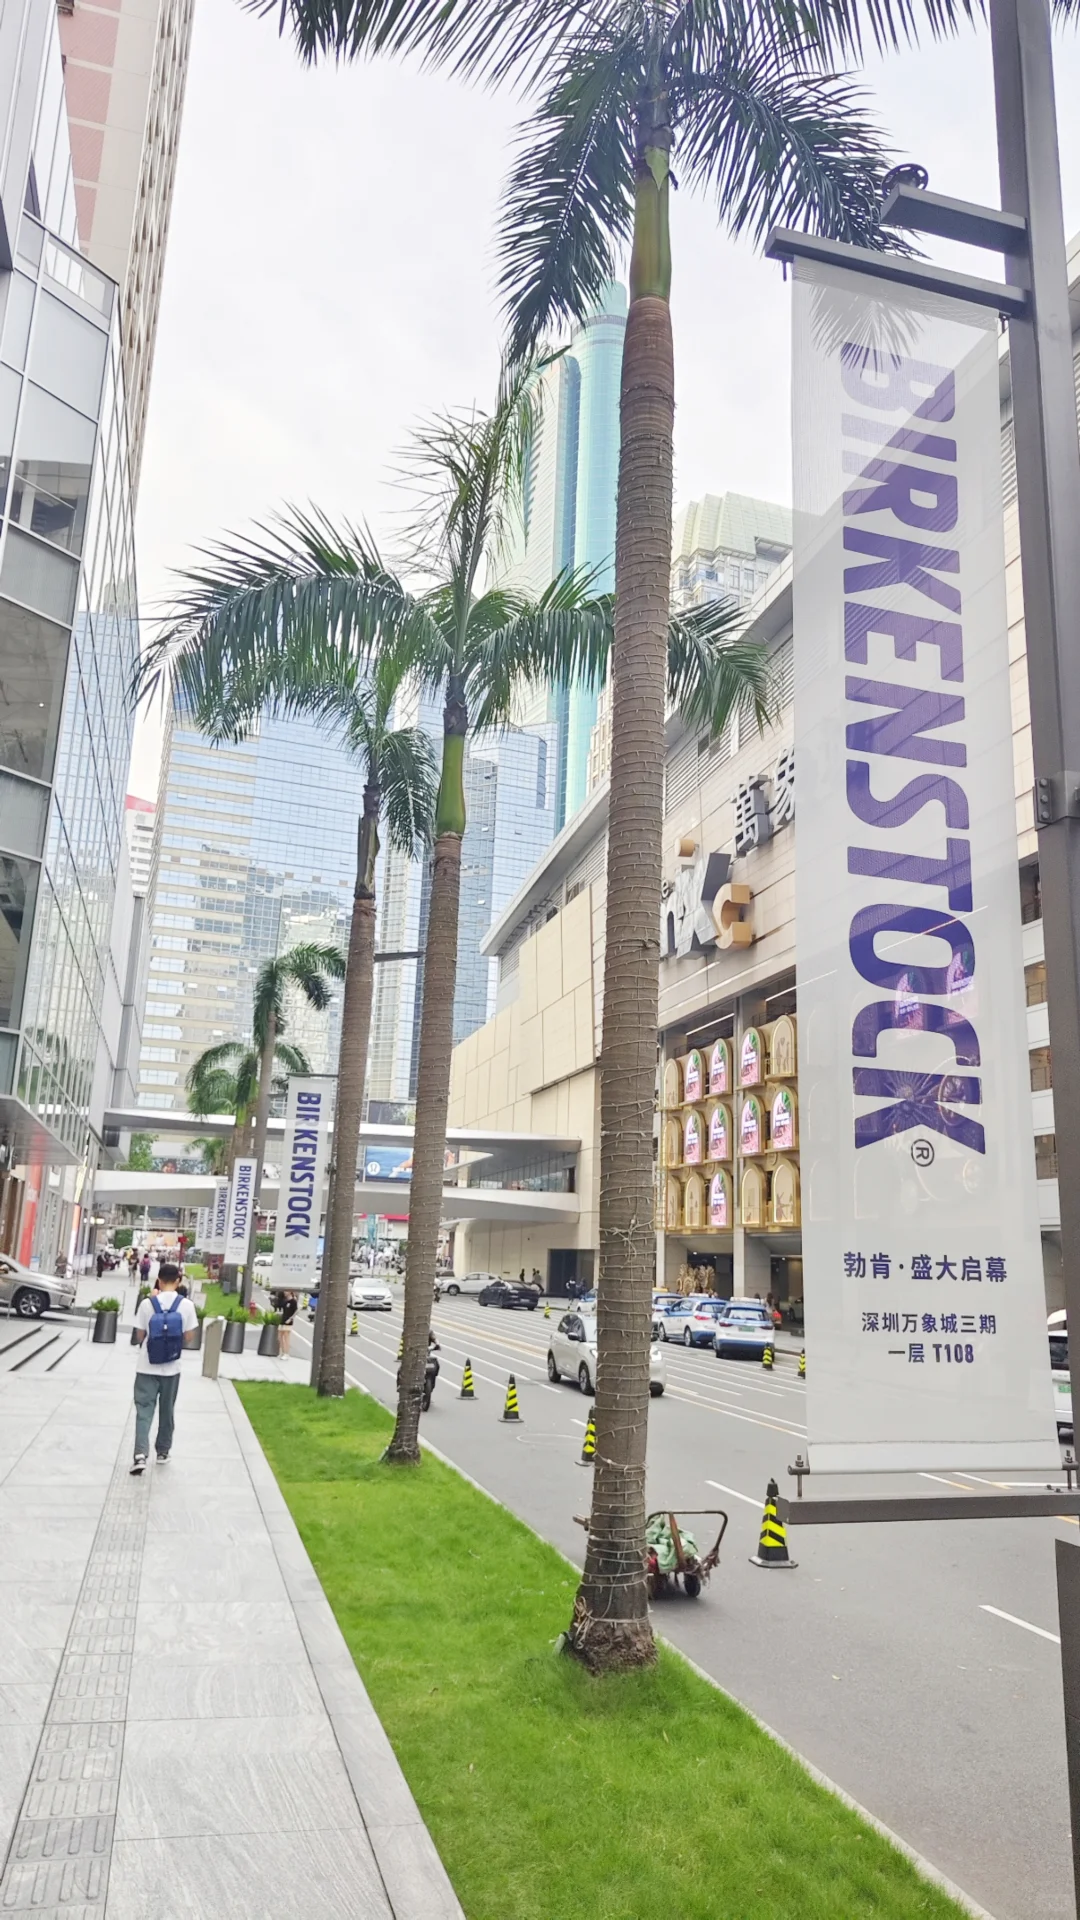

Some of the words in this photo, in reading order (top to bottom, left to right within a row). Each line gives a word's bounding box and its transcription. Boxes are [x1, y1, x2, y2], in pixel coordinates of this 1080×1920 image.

[232, 1165, 252, 1239] BIRKENSTOCK
[844, 1251, 1008, 1283] 勃肯·盛大启幕
[862, 1312, 996, 1335] 深圳万象城三期
[888, 1343, 925, 1363] 一层
[932, 1344, 974, 1363] T108
